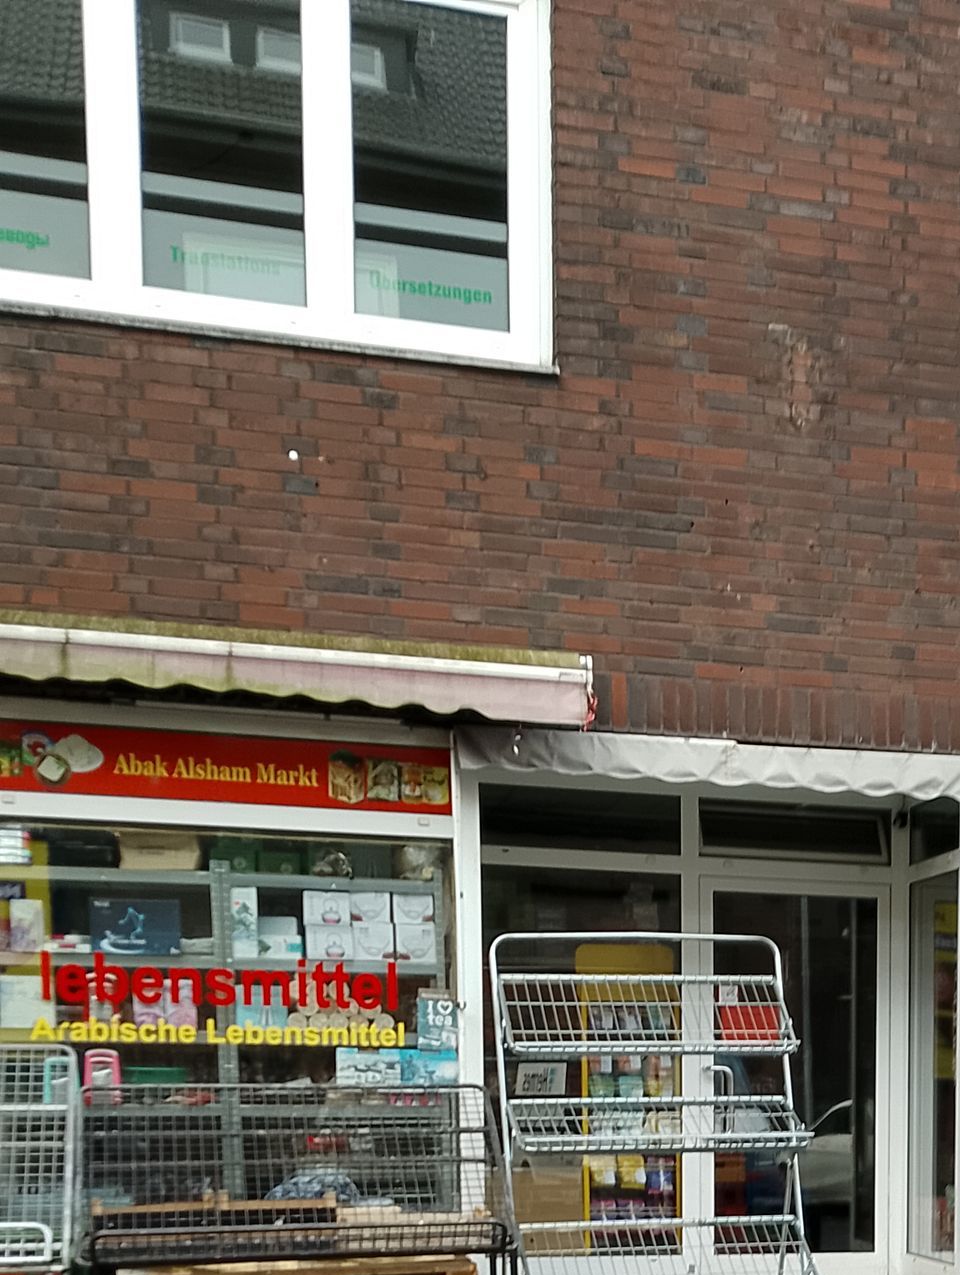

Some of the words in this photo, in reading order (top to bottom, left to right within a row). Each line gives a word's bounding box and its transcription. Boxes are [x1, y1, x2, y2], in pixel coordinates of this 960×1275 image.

[113, 753, 170, 777] Abak
[173, 757, 252, 783] Alsham
[256, 762, 319, 788] Markt
[40, 950, 398, 1012] lebensmittel
[30, 1017, 197, 1044] Arabische
[206, 1019, 405, 1046] Lebensmittel
